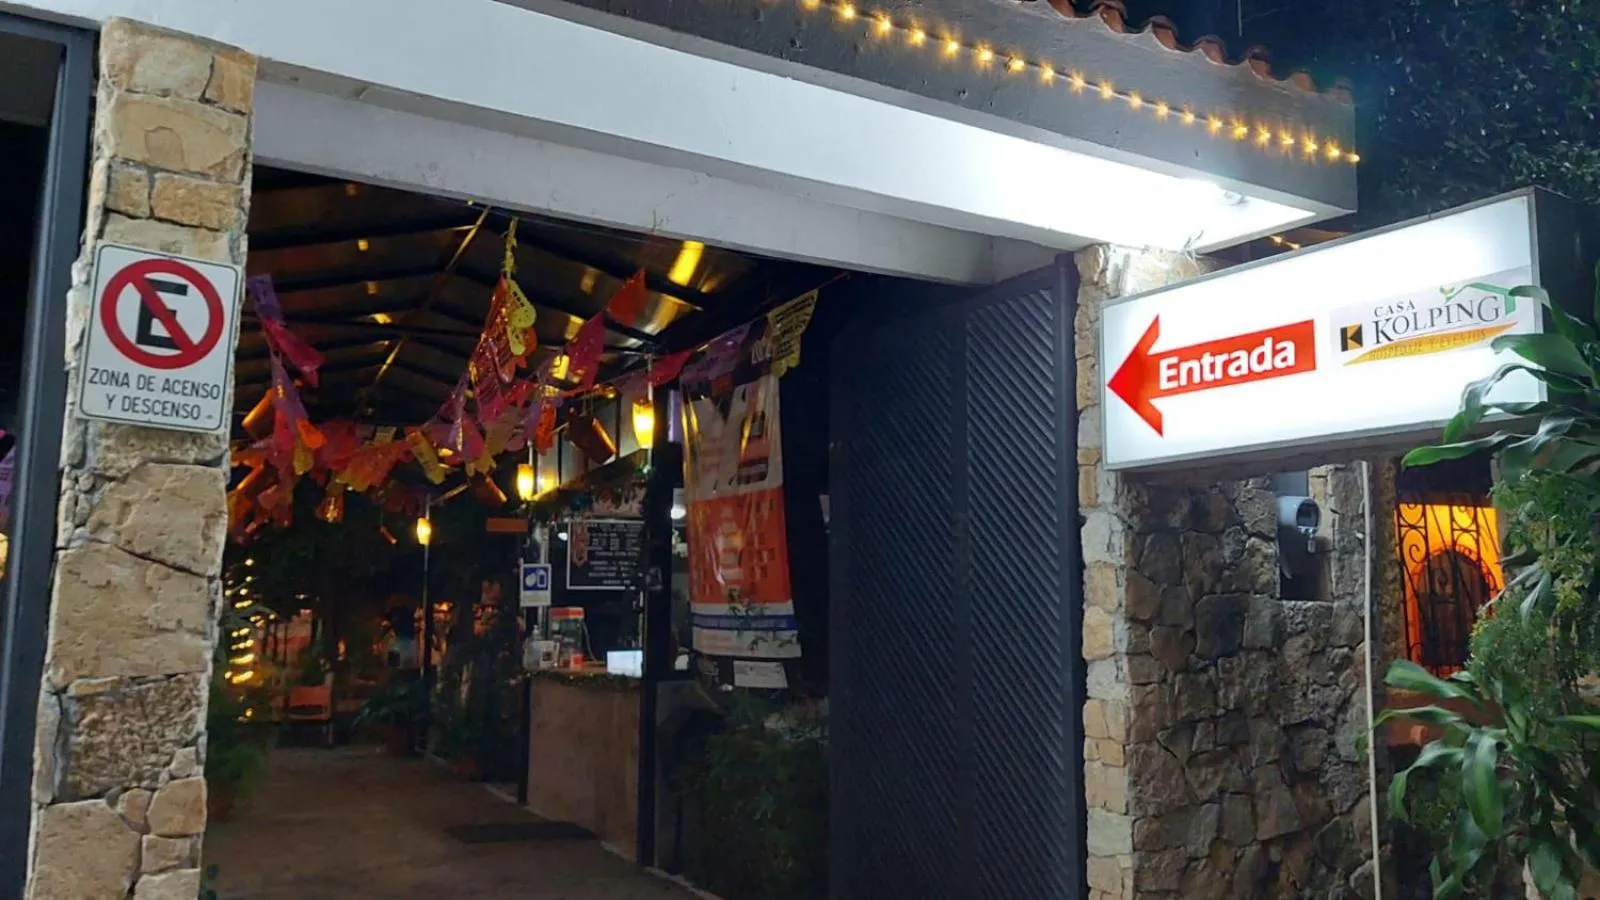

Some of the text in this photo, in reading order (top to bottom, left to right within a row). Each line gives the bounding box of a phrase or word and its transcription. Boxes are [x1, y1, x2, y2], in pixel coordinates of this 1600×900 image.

[136, 278, 188, 350] E
[1372, 295, 1501, 345] KOLPING
[1374, 300, 1416, 318] CASA
[88, 367, 221, 400] ZONA DE ACENSO
[1159, 336, 1296, 390] Entrada
[106, 393, 201, 421] Y DESCENSO
